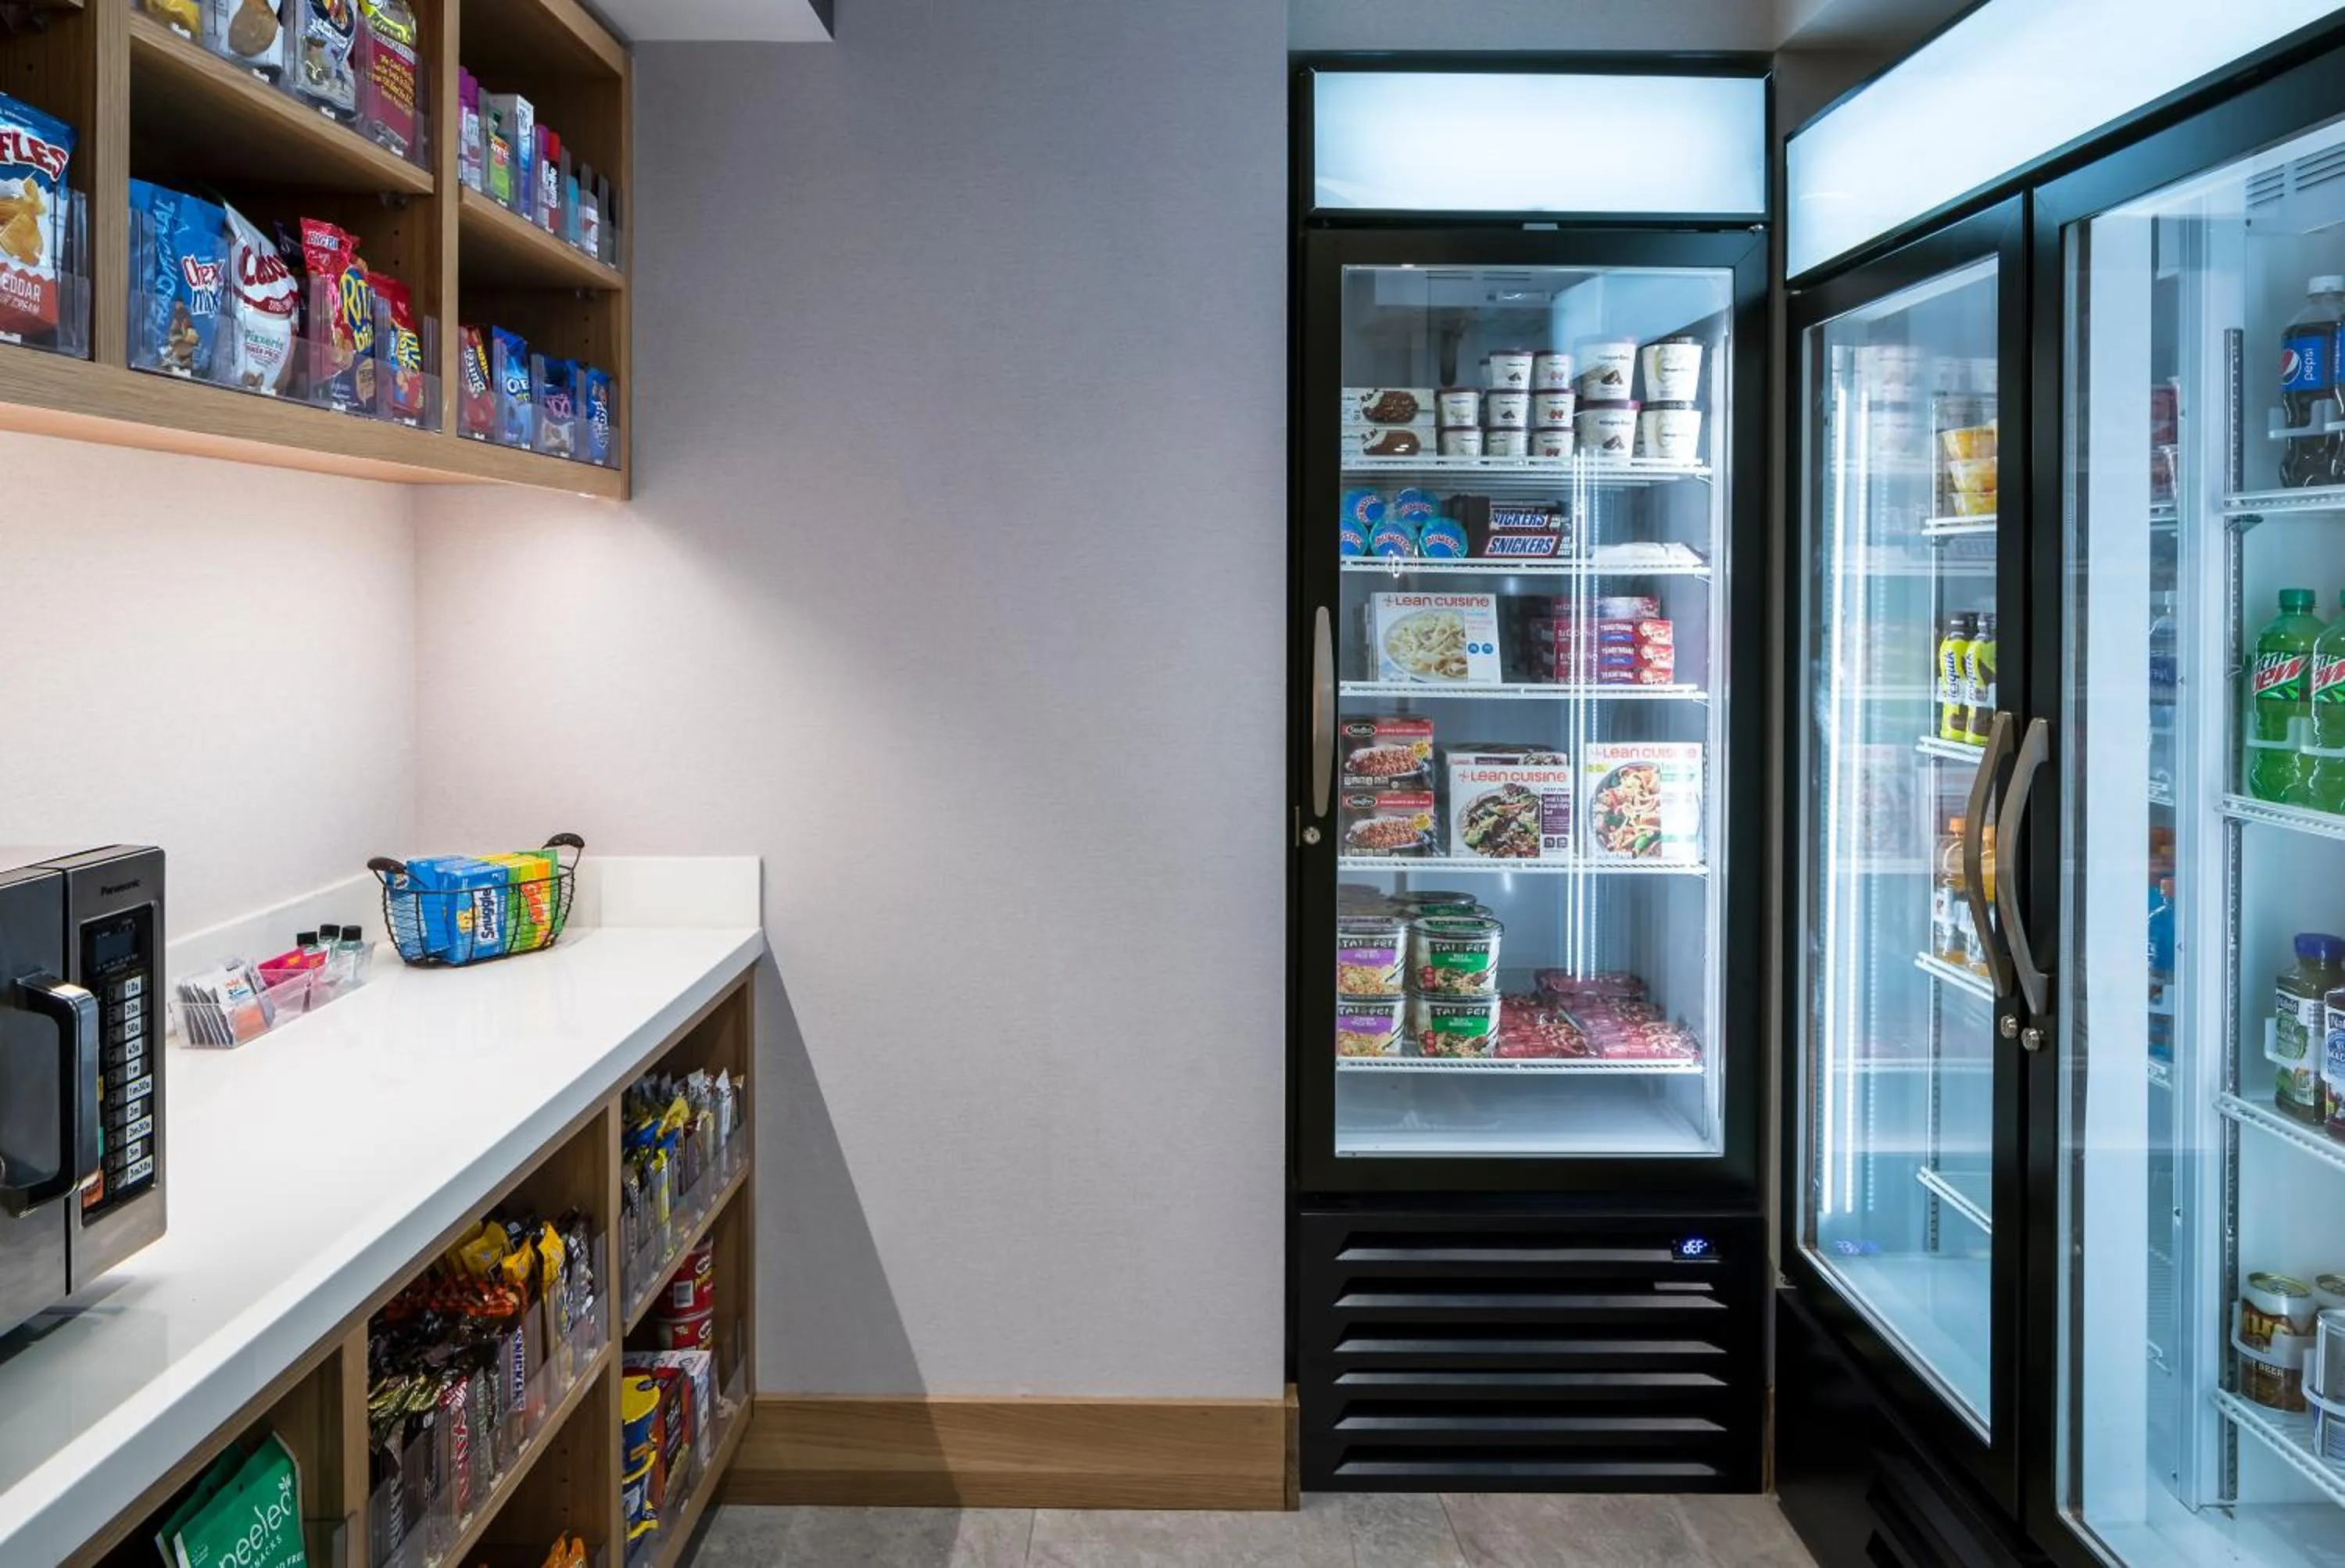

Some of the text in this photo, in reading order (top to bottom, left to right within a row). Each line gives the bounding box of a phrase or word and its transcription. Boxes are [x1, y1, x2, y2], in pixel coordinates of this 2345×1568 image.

[0, 129, 67, 180] FLES
[0, 272, 41, 303] EDDAR
[2304, 347, 2316, 381] pepsi
[1491, 512, 1547, 526] NICKERS
[1488, 537, 1554, 554] SNICKERS
[101, 879, 141, 897] Panasonic
[480, 888, 495, 940] Snuggle
